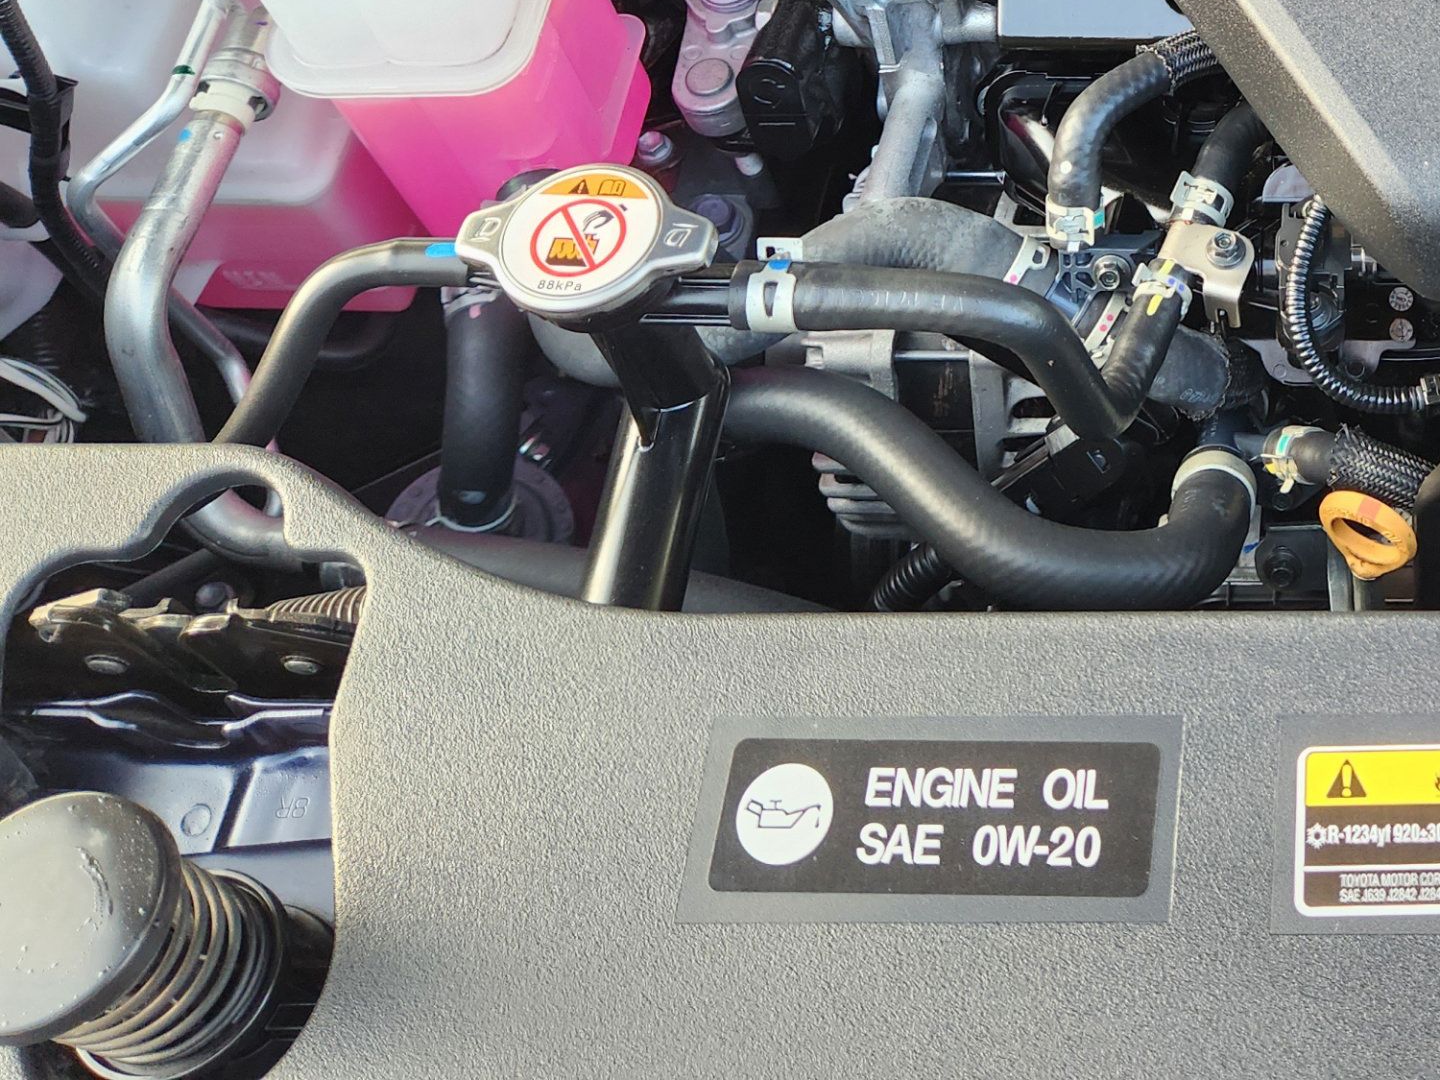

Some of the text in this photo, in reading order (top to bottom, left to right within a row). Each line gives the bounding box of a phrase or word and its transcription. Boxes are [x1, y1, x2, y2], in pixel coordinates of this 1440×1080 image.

[536, 278, 582, 292] 88kPa
[864, 767, 1109, 810] ENGINE OIL
[856, 823, 1102, 867] SAE 0W-20
[1339, 873, 1380, 888] TOYOTA
[1380, 872, 1419, 887] MOTOR
[1339, 888, 1361, 902] SAE
